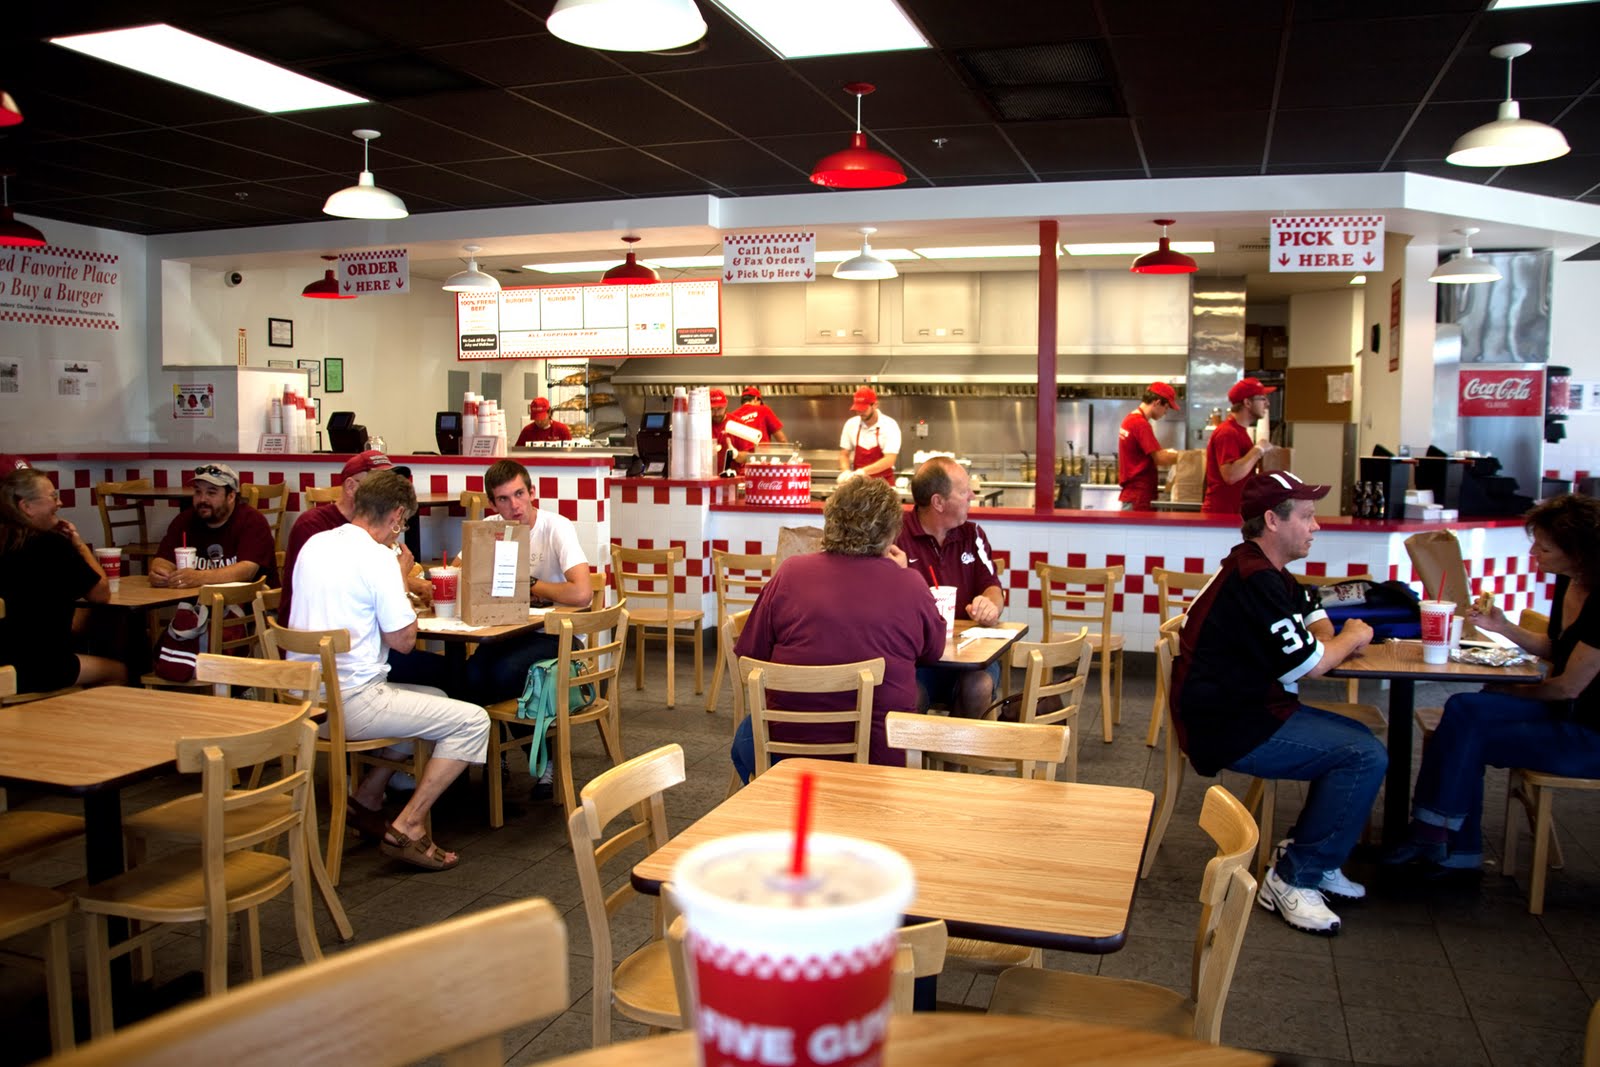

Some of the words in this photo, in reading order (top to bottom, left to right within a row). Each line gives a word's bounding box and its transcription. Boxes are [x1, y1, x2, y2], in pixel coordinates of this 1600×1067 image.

[1278, 230, 1334, 247] PICK
[1342, 229, 1377, 246] UP
[737, 246, 761, 256] Call
[763, 245, 800, 255] Ahead
[732, 257, 742, 266] &
[743, 257, 764, 266] Fax
[766, 256, 806, 265] Orders
[1298, 253, 1355, 267] HERE
[20, 255, 79, 280] Favorite
[82, 263, 118, 285] Place
[347, 261, 399, 276] ORDER
[737, 269, 759, 279] Pick
[761, 269, 775, 279] Up
[777, 268, 801, 278] Here
[10, 277, 40, 303] Buy
[43, 286, 52, 300] a
[56, 283, 104, 308] Burger
[355, 279, 392, 292] HERE
[1463, 378, 1534, 400] Coca-Cola
[787, 480, 809, 490] FIVE
